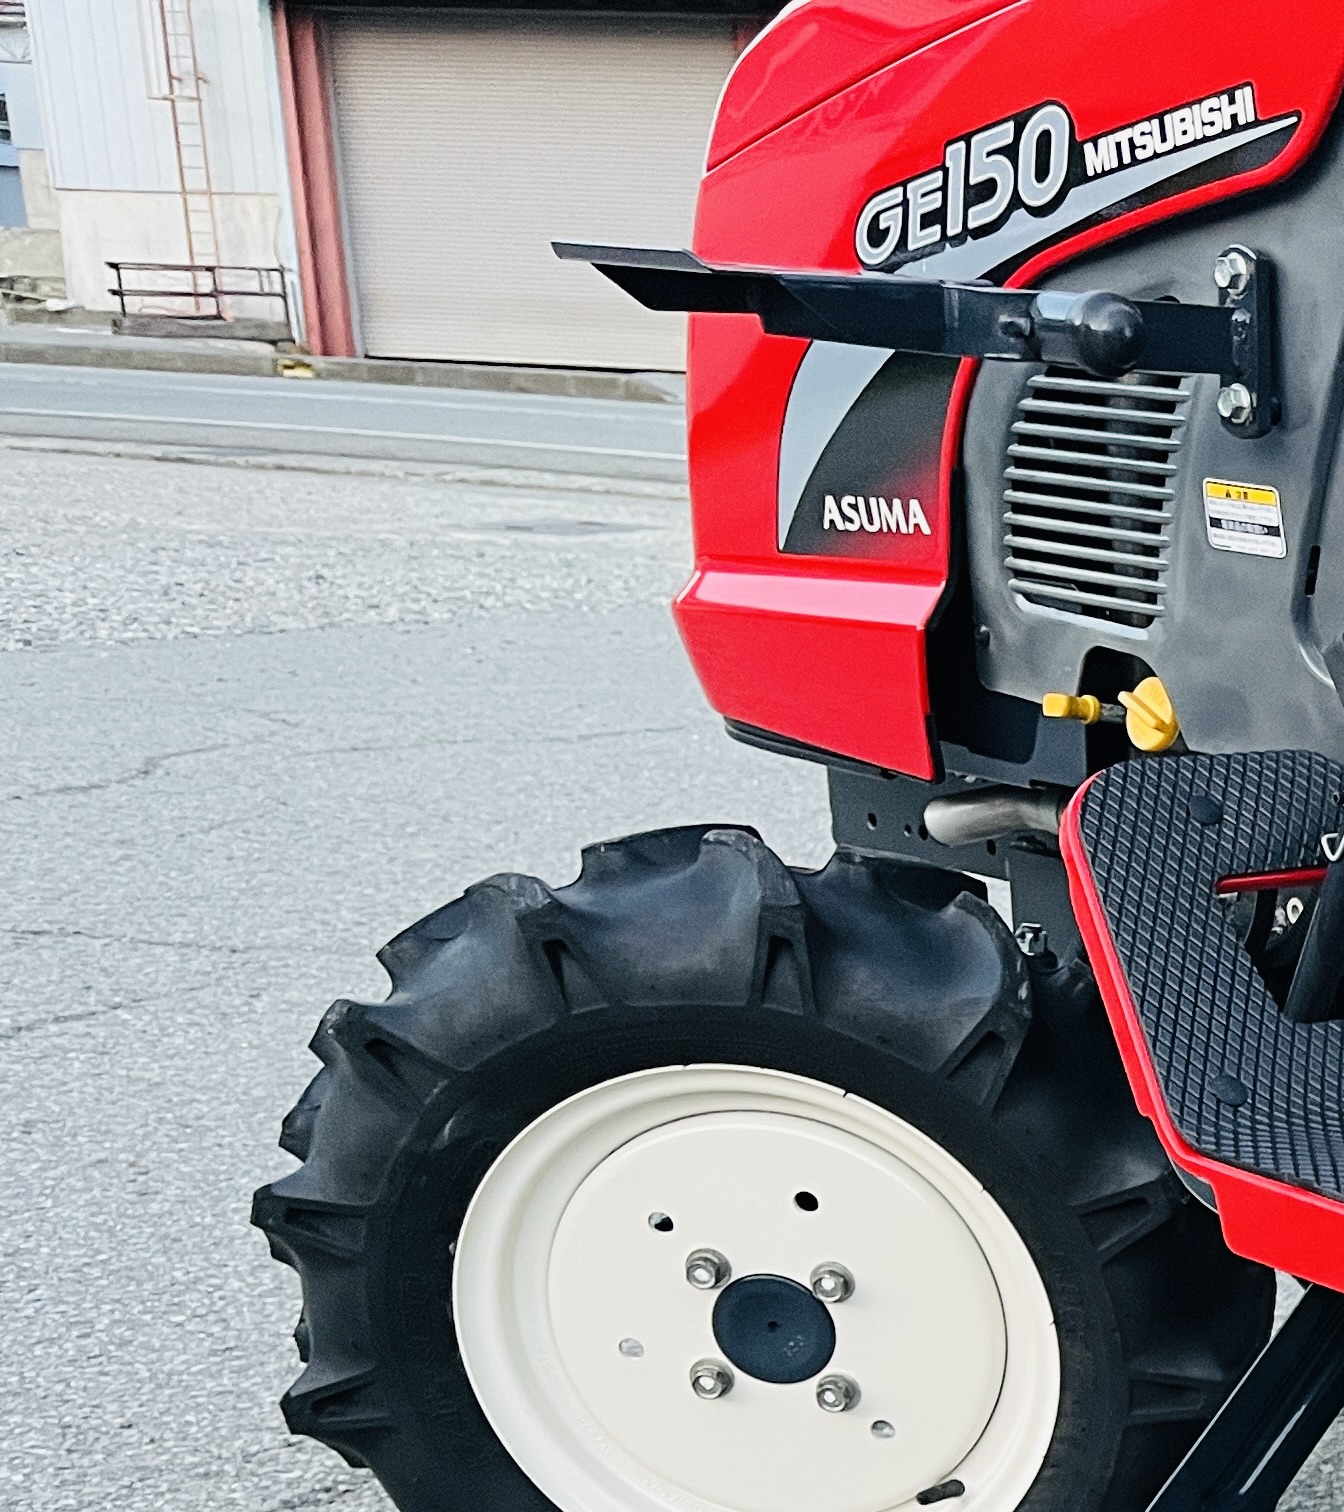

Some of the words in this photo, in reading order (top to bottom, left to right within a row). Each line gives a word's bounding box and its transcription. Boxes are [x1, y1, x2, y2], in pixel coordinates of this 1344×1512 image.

[855, 104, 1071, 265] GE150
[1083, 85, 1257, 177] MITSUBISHI
[823, 494, 932, 536] ASUMA
